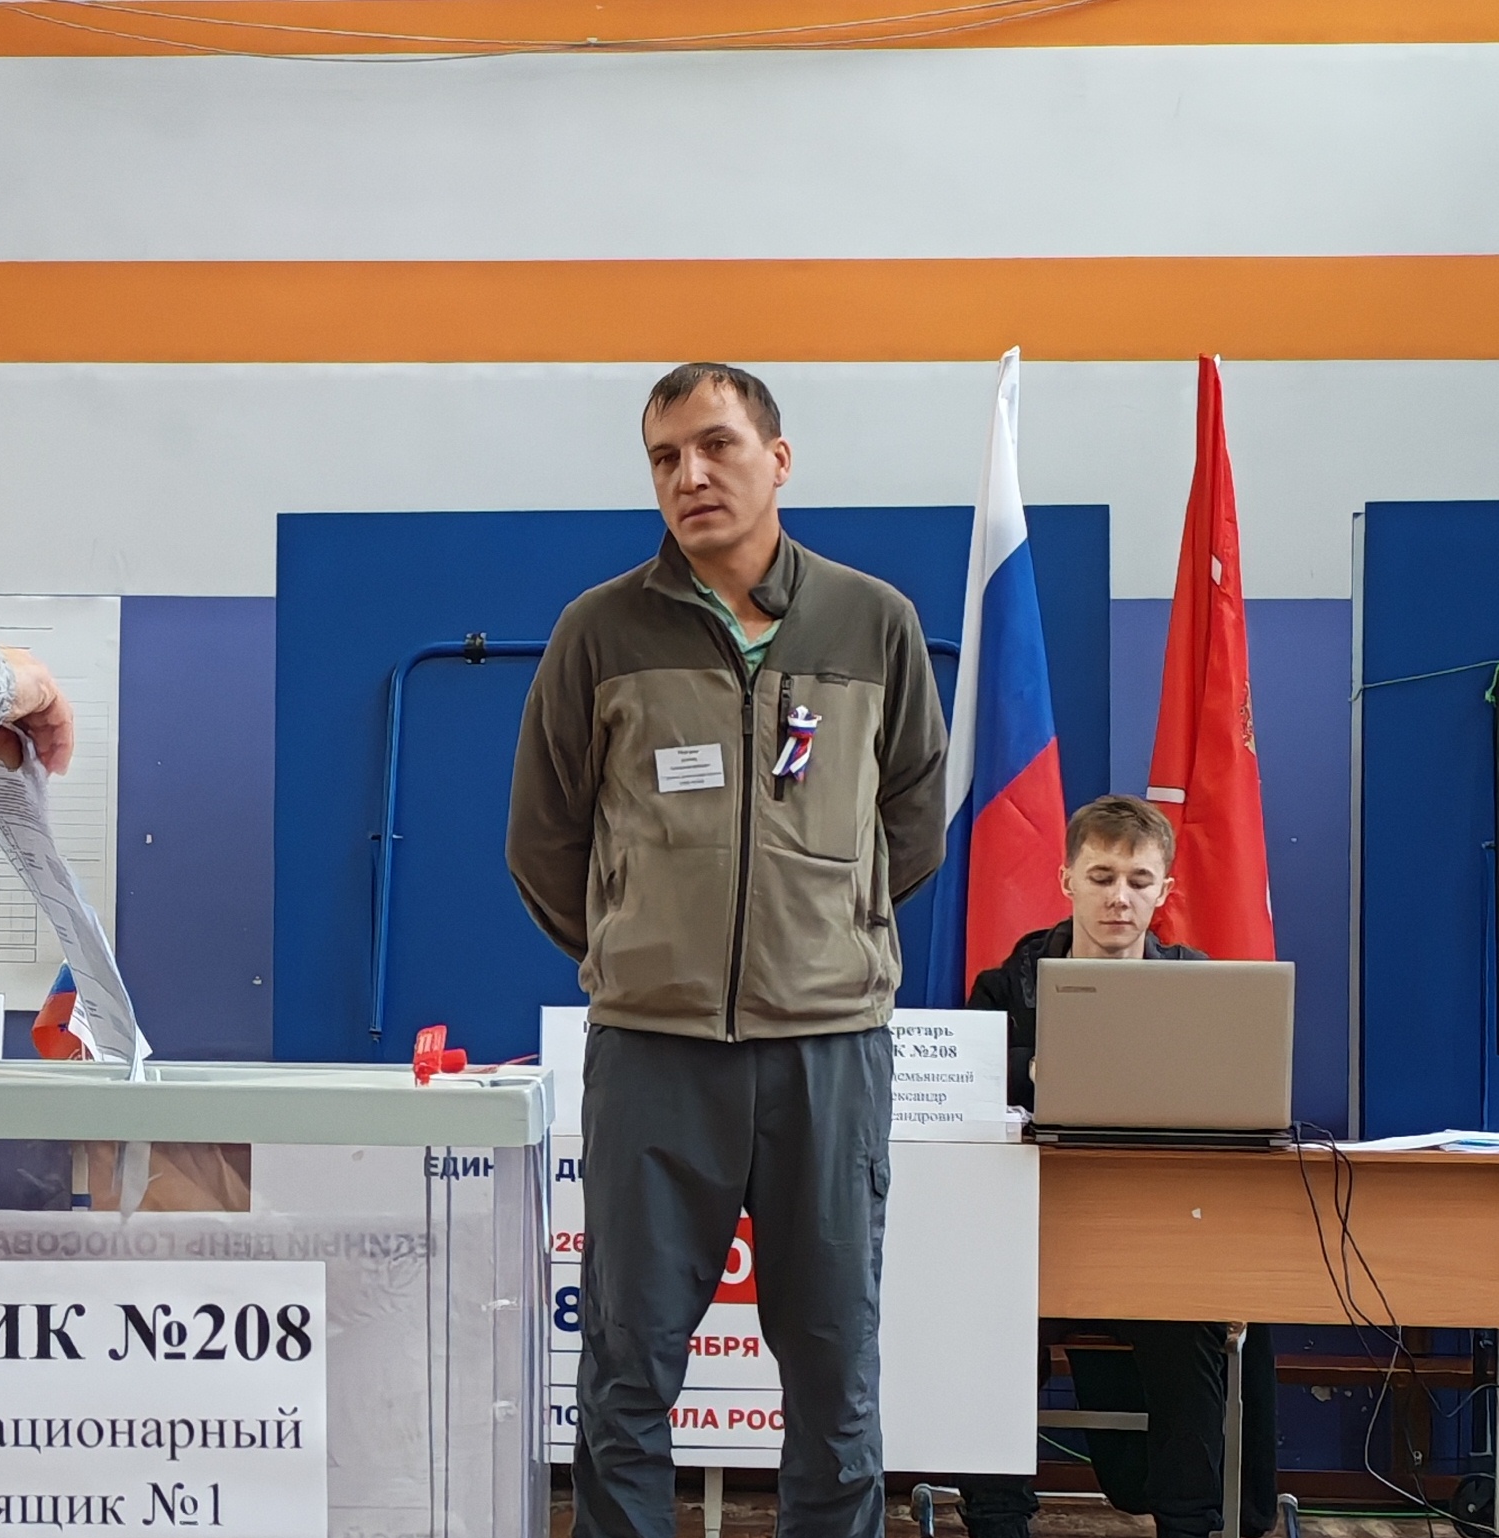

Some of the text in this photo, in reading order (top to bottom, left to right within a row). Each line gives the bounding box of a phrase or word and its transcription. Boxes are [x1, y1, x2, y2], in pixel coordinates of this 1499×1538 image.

[909, 1044, 958, 1059] №208
[550, 1232, 586, 1252] 26
[107, 1302, 313, 1362] №208
[141, 1481, 223, 1527] №1
